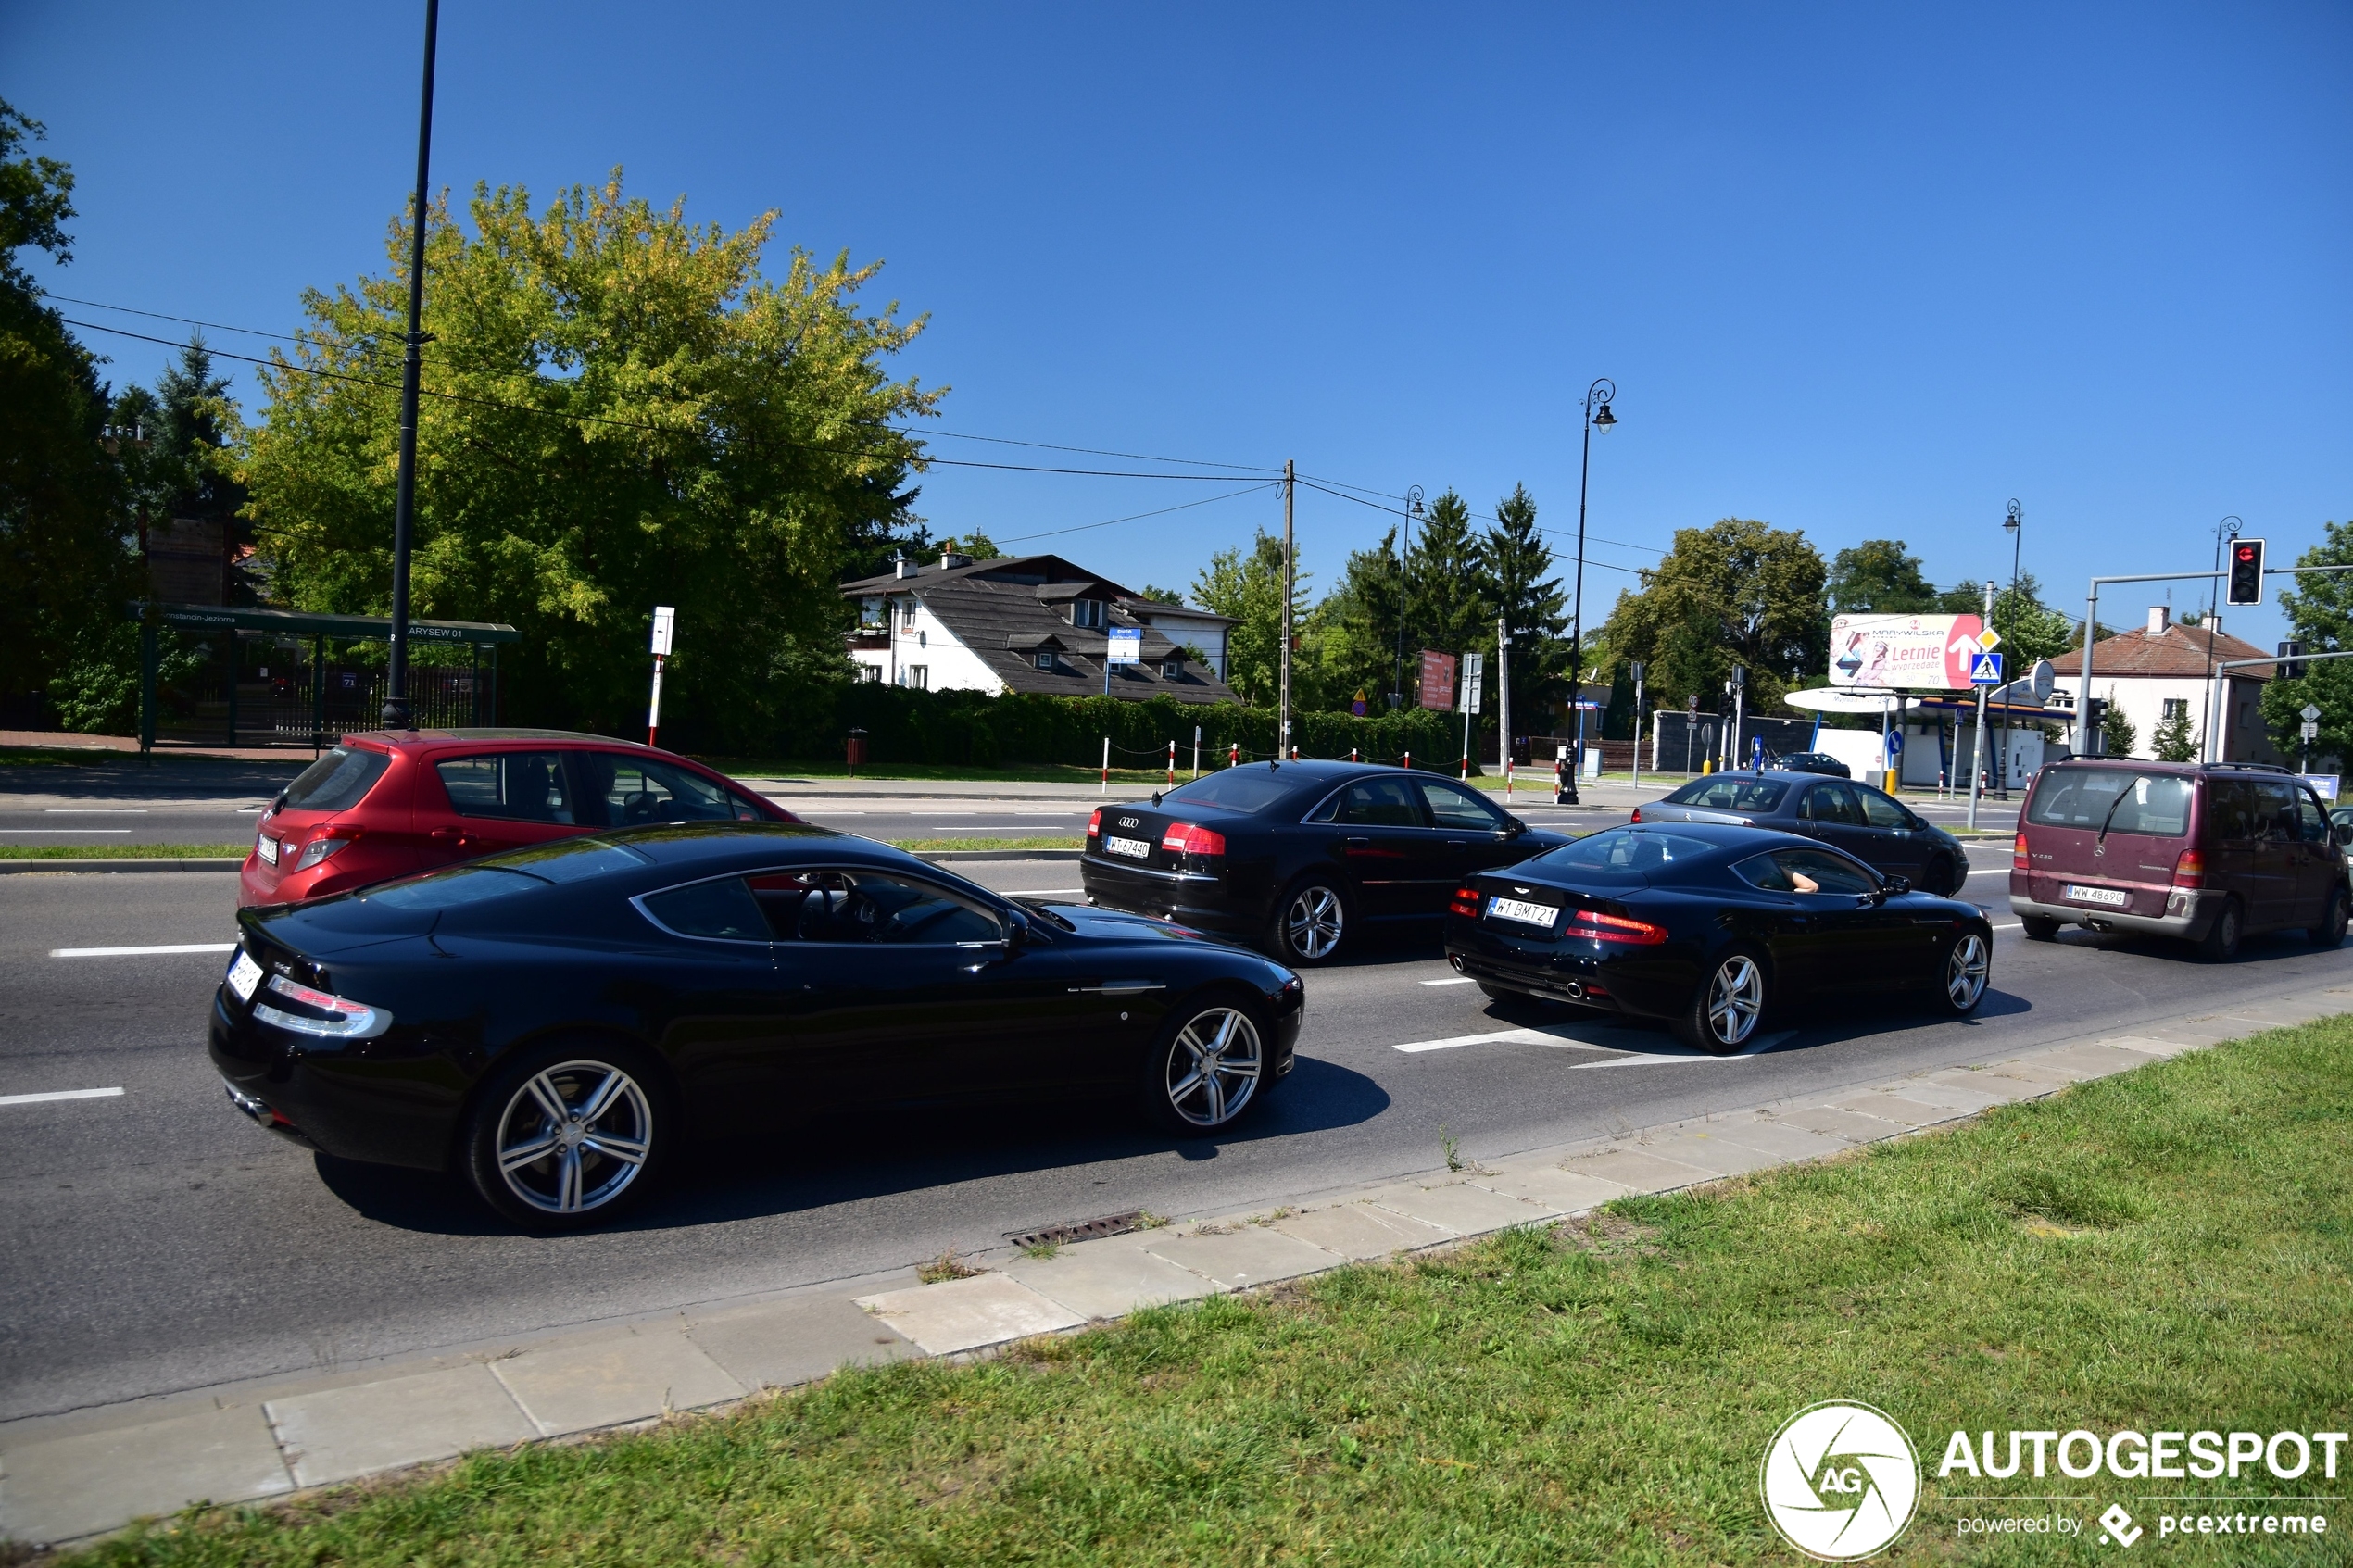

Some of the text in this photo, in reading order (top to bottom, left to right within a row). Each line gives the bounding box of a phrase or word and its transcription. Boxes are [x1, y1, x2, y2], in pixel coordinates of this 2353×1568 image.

[408, 628, 462, 638] ARYSEW 01
[1892, 644, 1941, 661] Letnie
[344, 678, 355, 686] 71
[1927, 674, 1940, 685] 70
[1111, 837, 1122, 850] WT
[1122, 840, 1149, 856] 67440
[2073, 886, 2123, 902] WW 4869G
[1496, 898, 1554, 923] W1 BMT21
